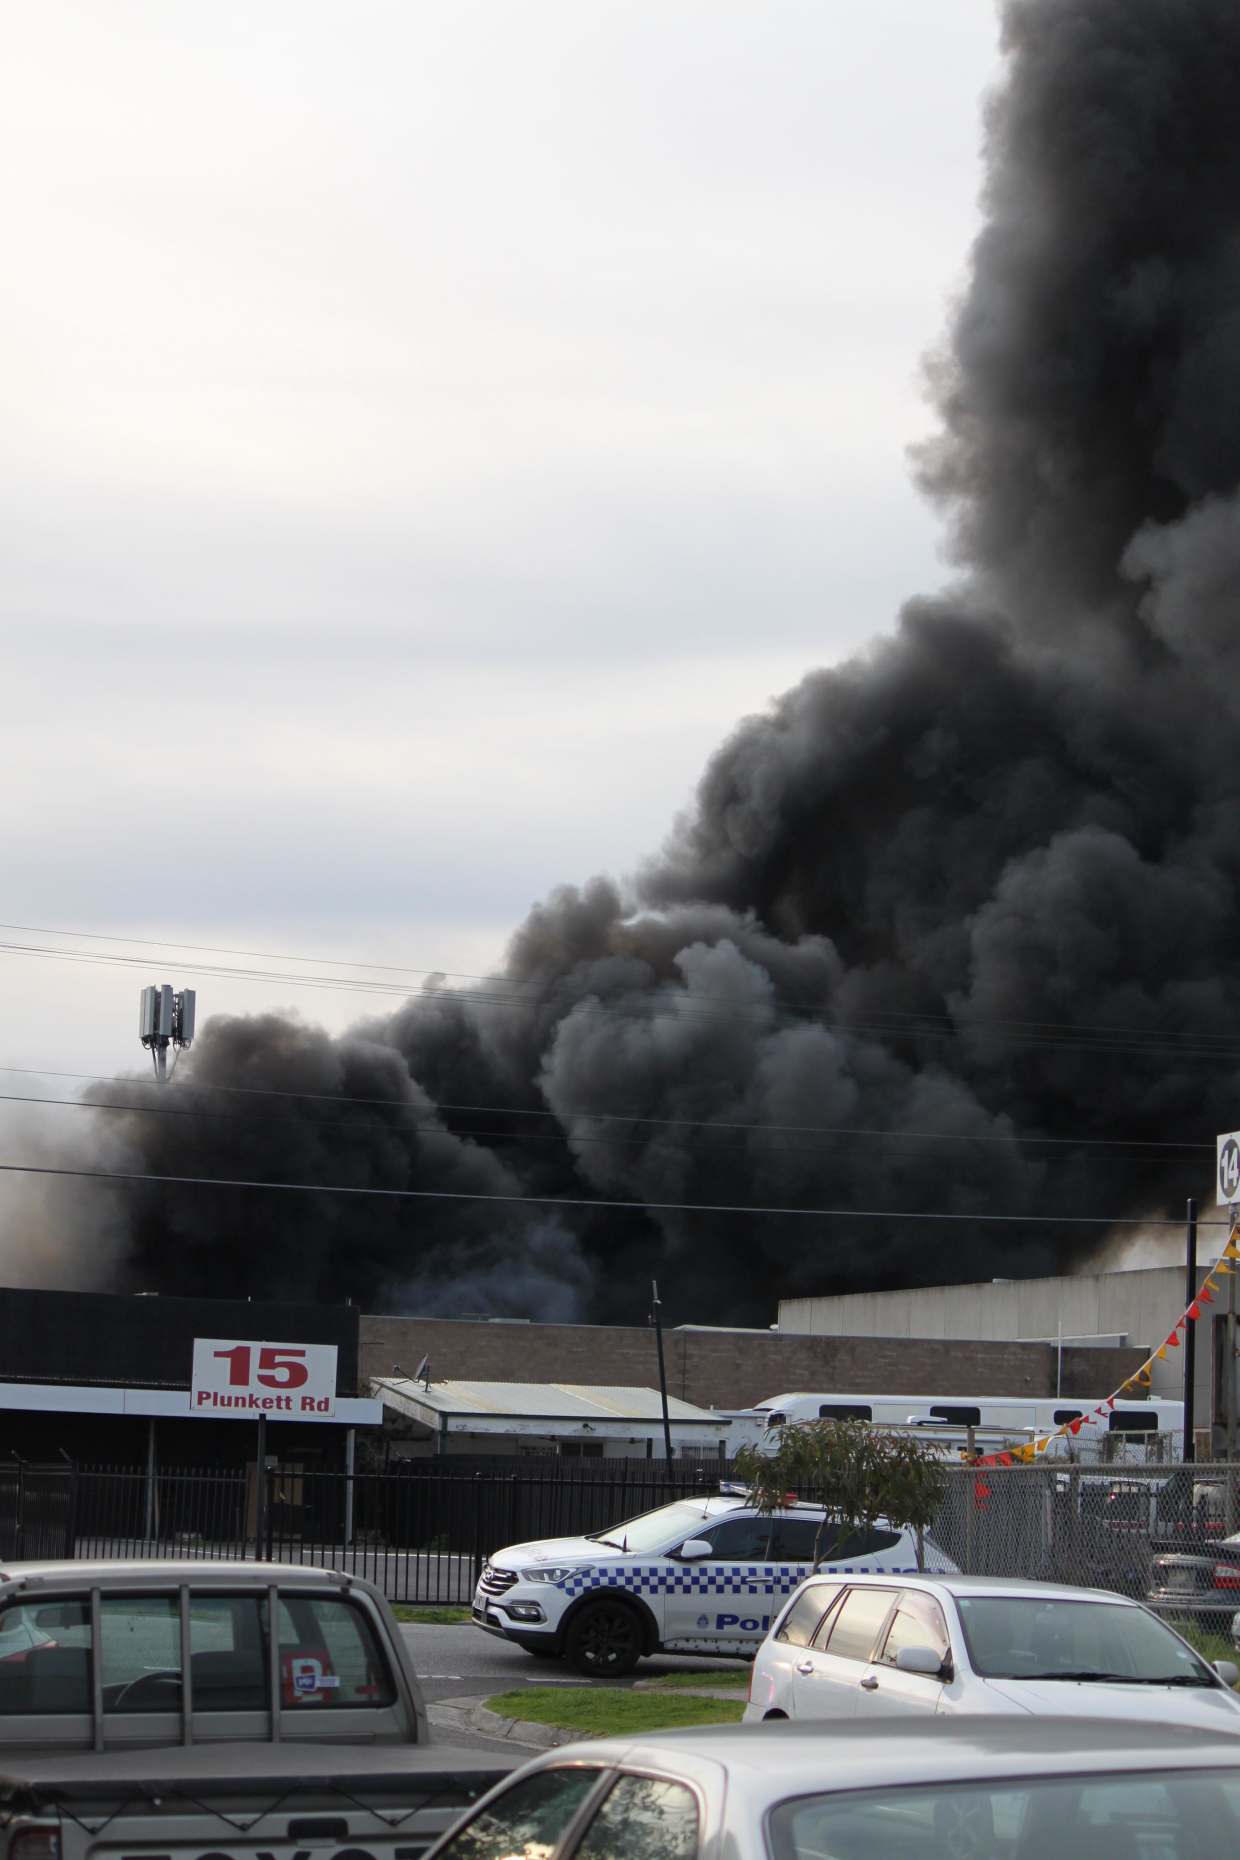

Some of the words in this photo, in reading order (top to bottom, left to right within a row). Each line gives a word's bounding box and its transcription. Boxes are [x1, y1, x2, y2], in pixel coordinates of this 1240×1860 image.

[1220, 1147, 1239, 1189] 14
[213, 1345, 309, 1389] 15
[197, 1391, 293, 1411] Plunkett
[300, 1396, 330, 1412] Rd
